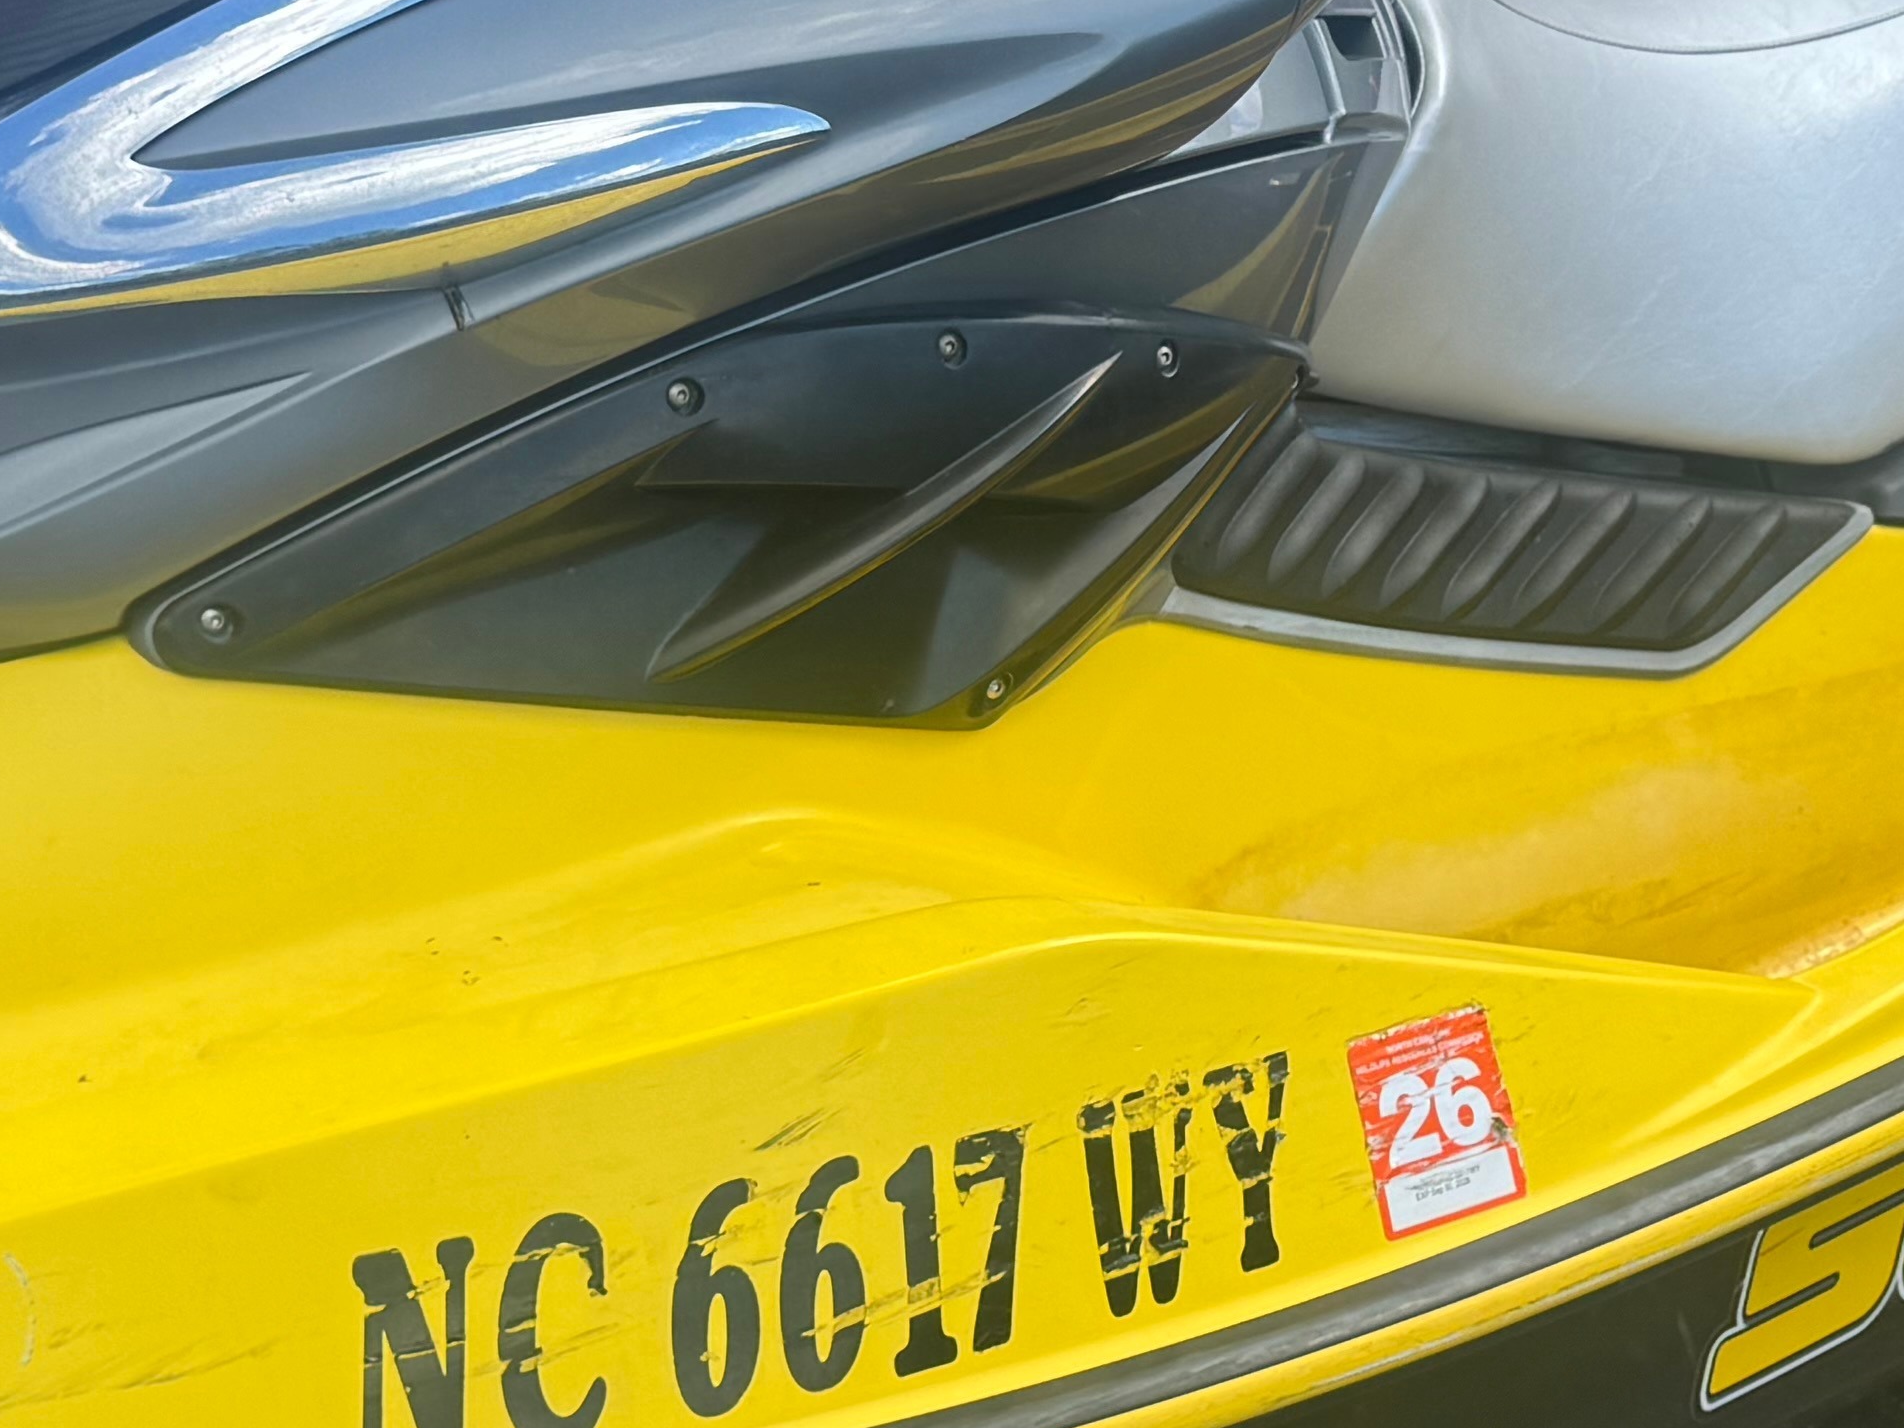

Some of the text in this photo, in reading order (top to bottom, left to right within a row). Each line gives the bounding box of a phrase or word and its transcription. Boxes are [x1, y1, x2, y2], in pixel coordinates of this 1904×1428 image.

[1378, 1057, 1494, 1169] 26
[671, 1122, 1032, 1419] 6617
[1076, 1050, 1289, 1318] WY
